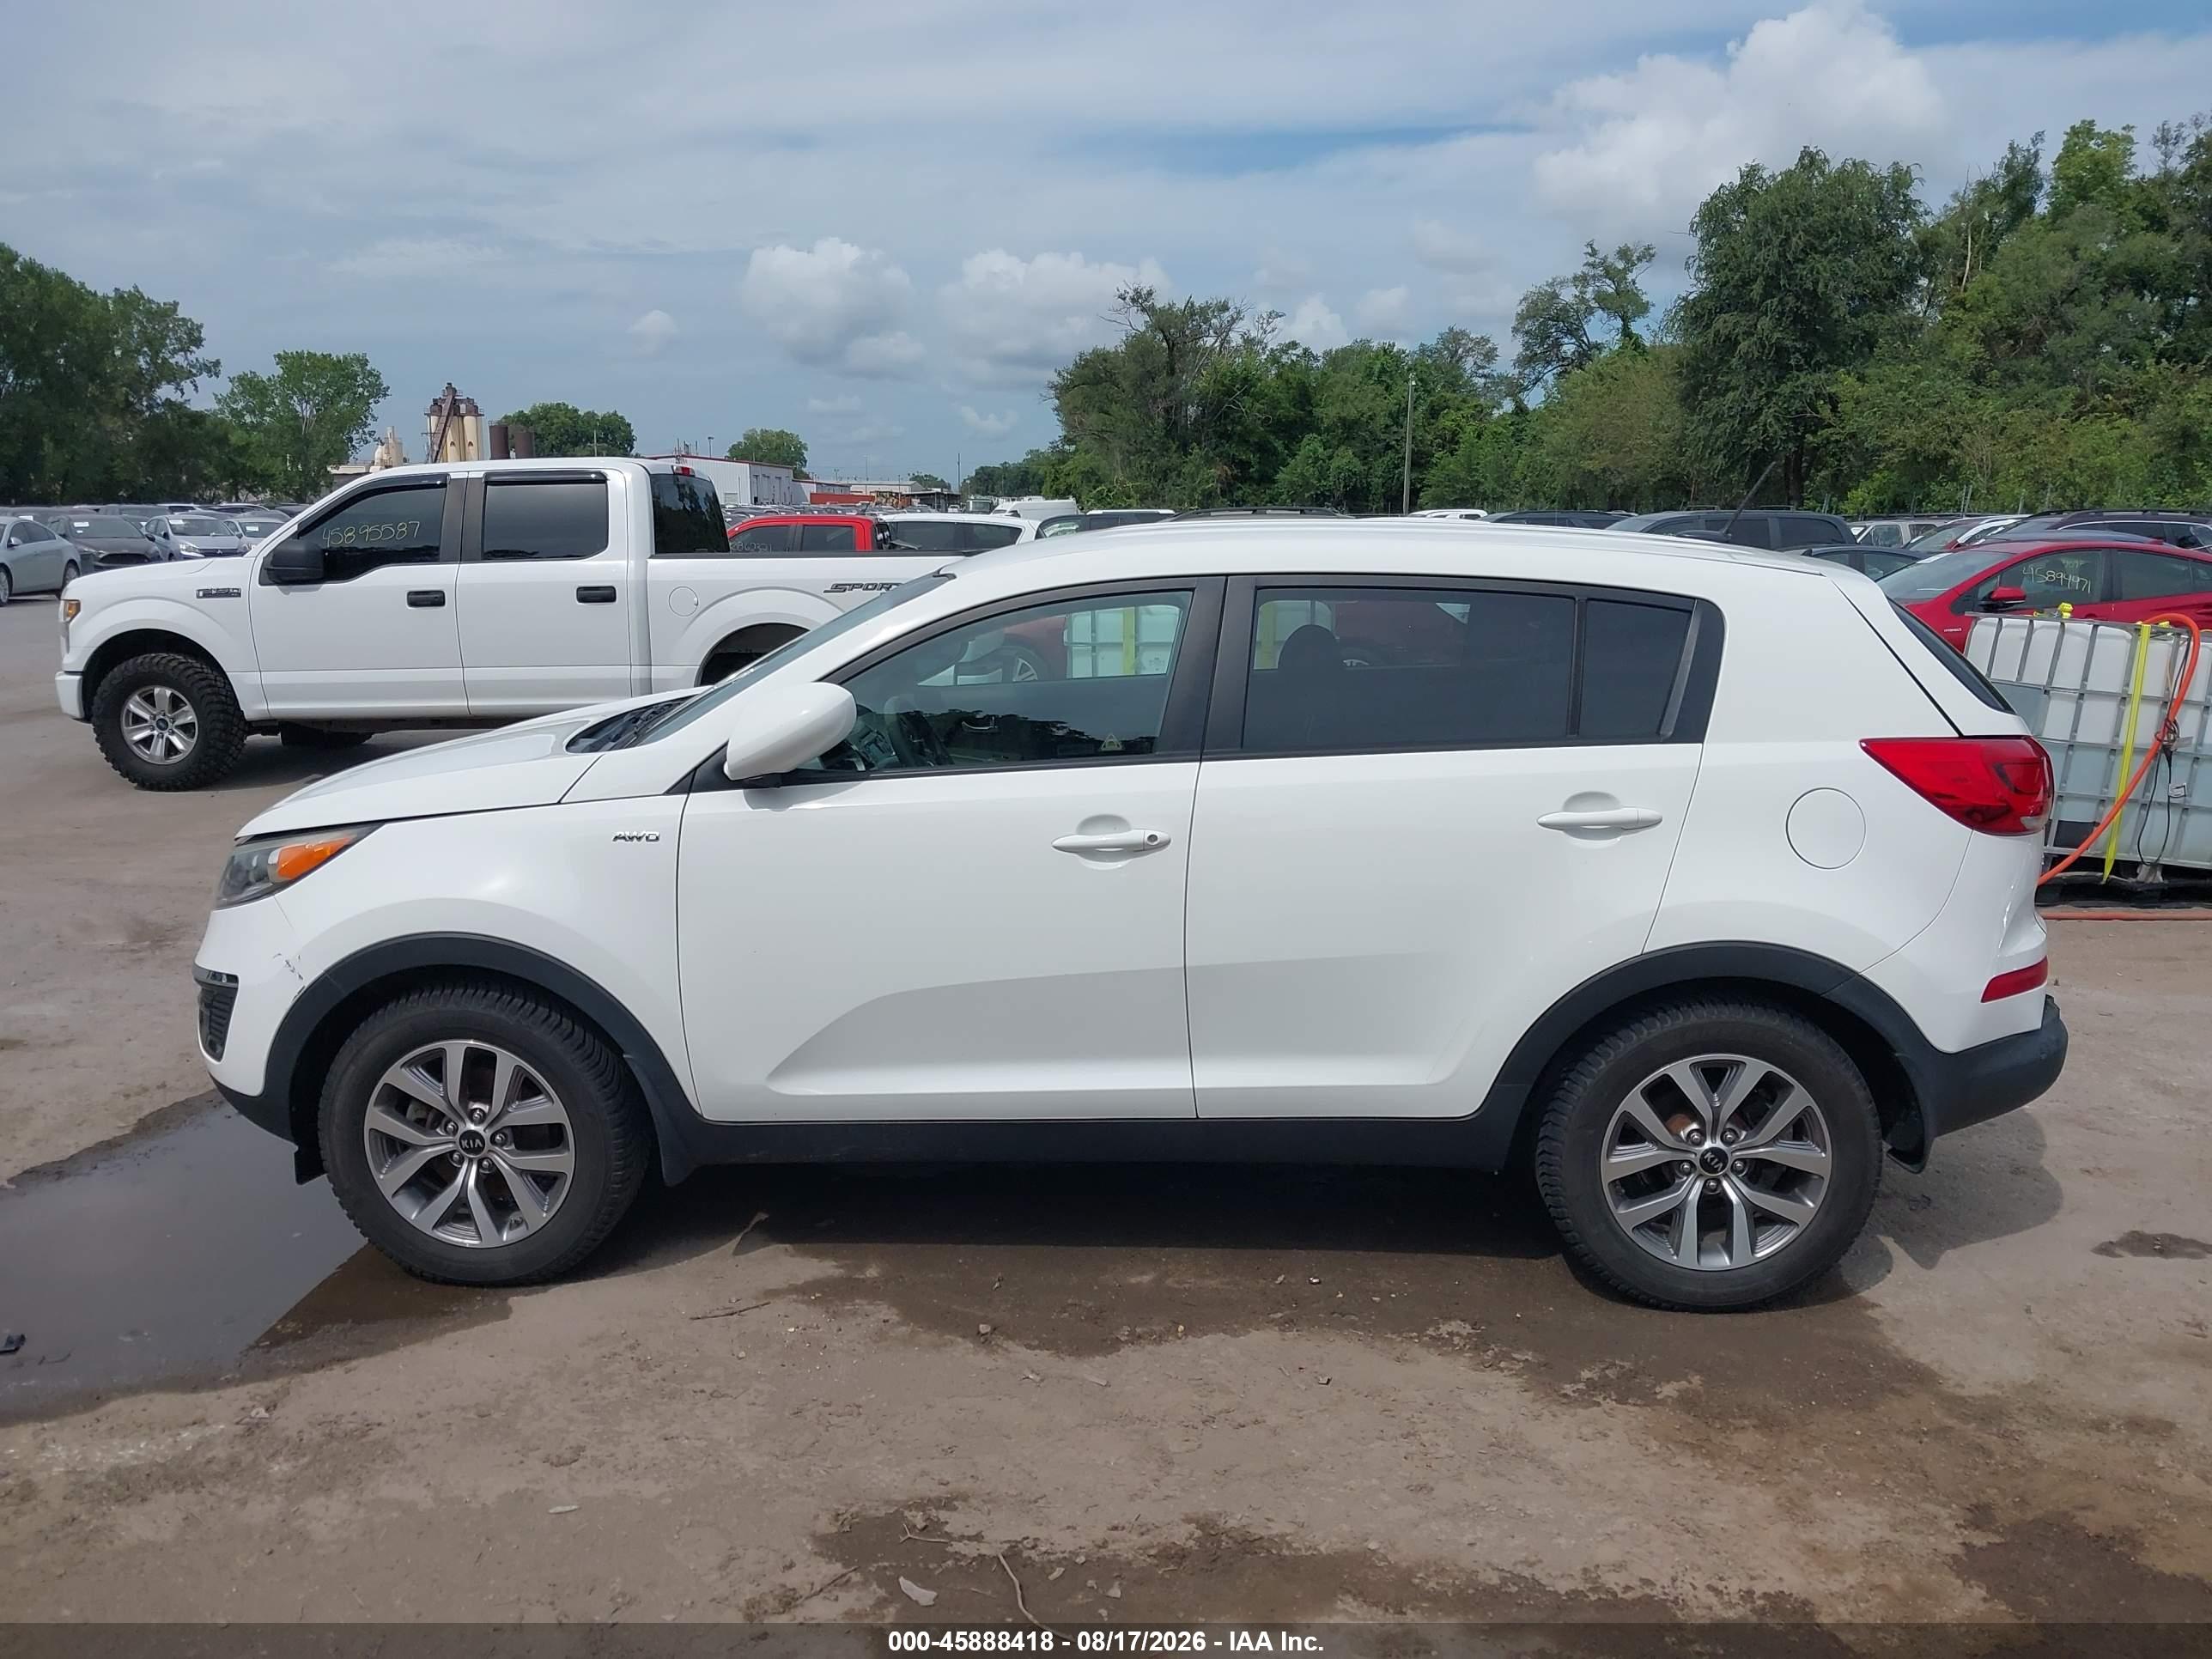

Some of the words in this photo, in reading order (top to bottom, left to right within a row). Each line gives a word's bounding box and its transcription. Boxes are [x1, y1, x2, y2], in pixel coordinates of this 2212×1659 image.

[322, 520, 420, 548] 45895587
[612, 831, 660, 842] AWD
[461, 1139, 483, 1149] KIA
